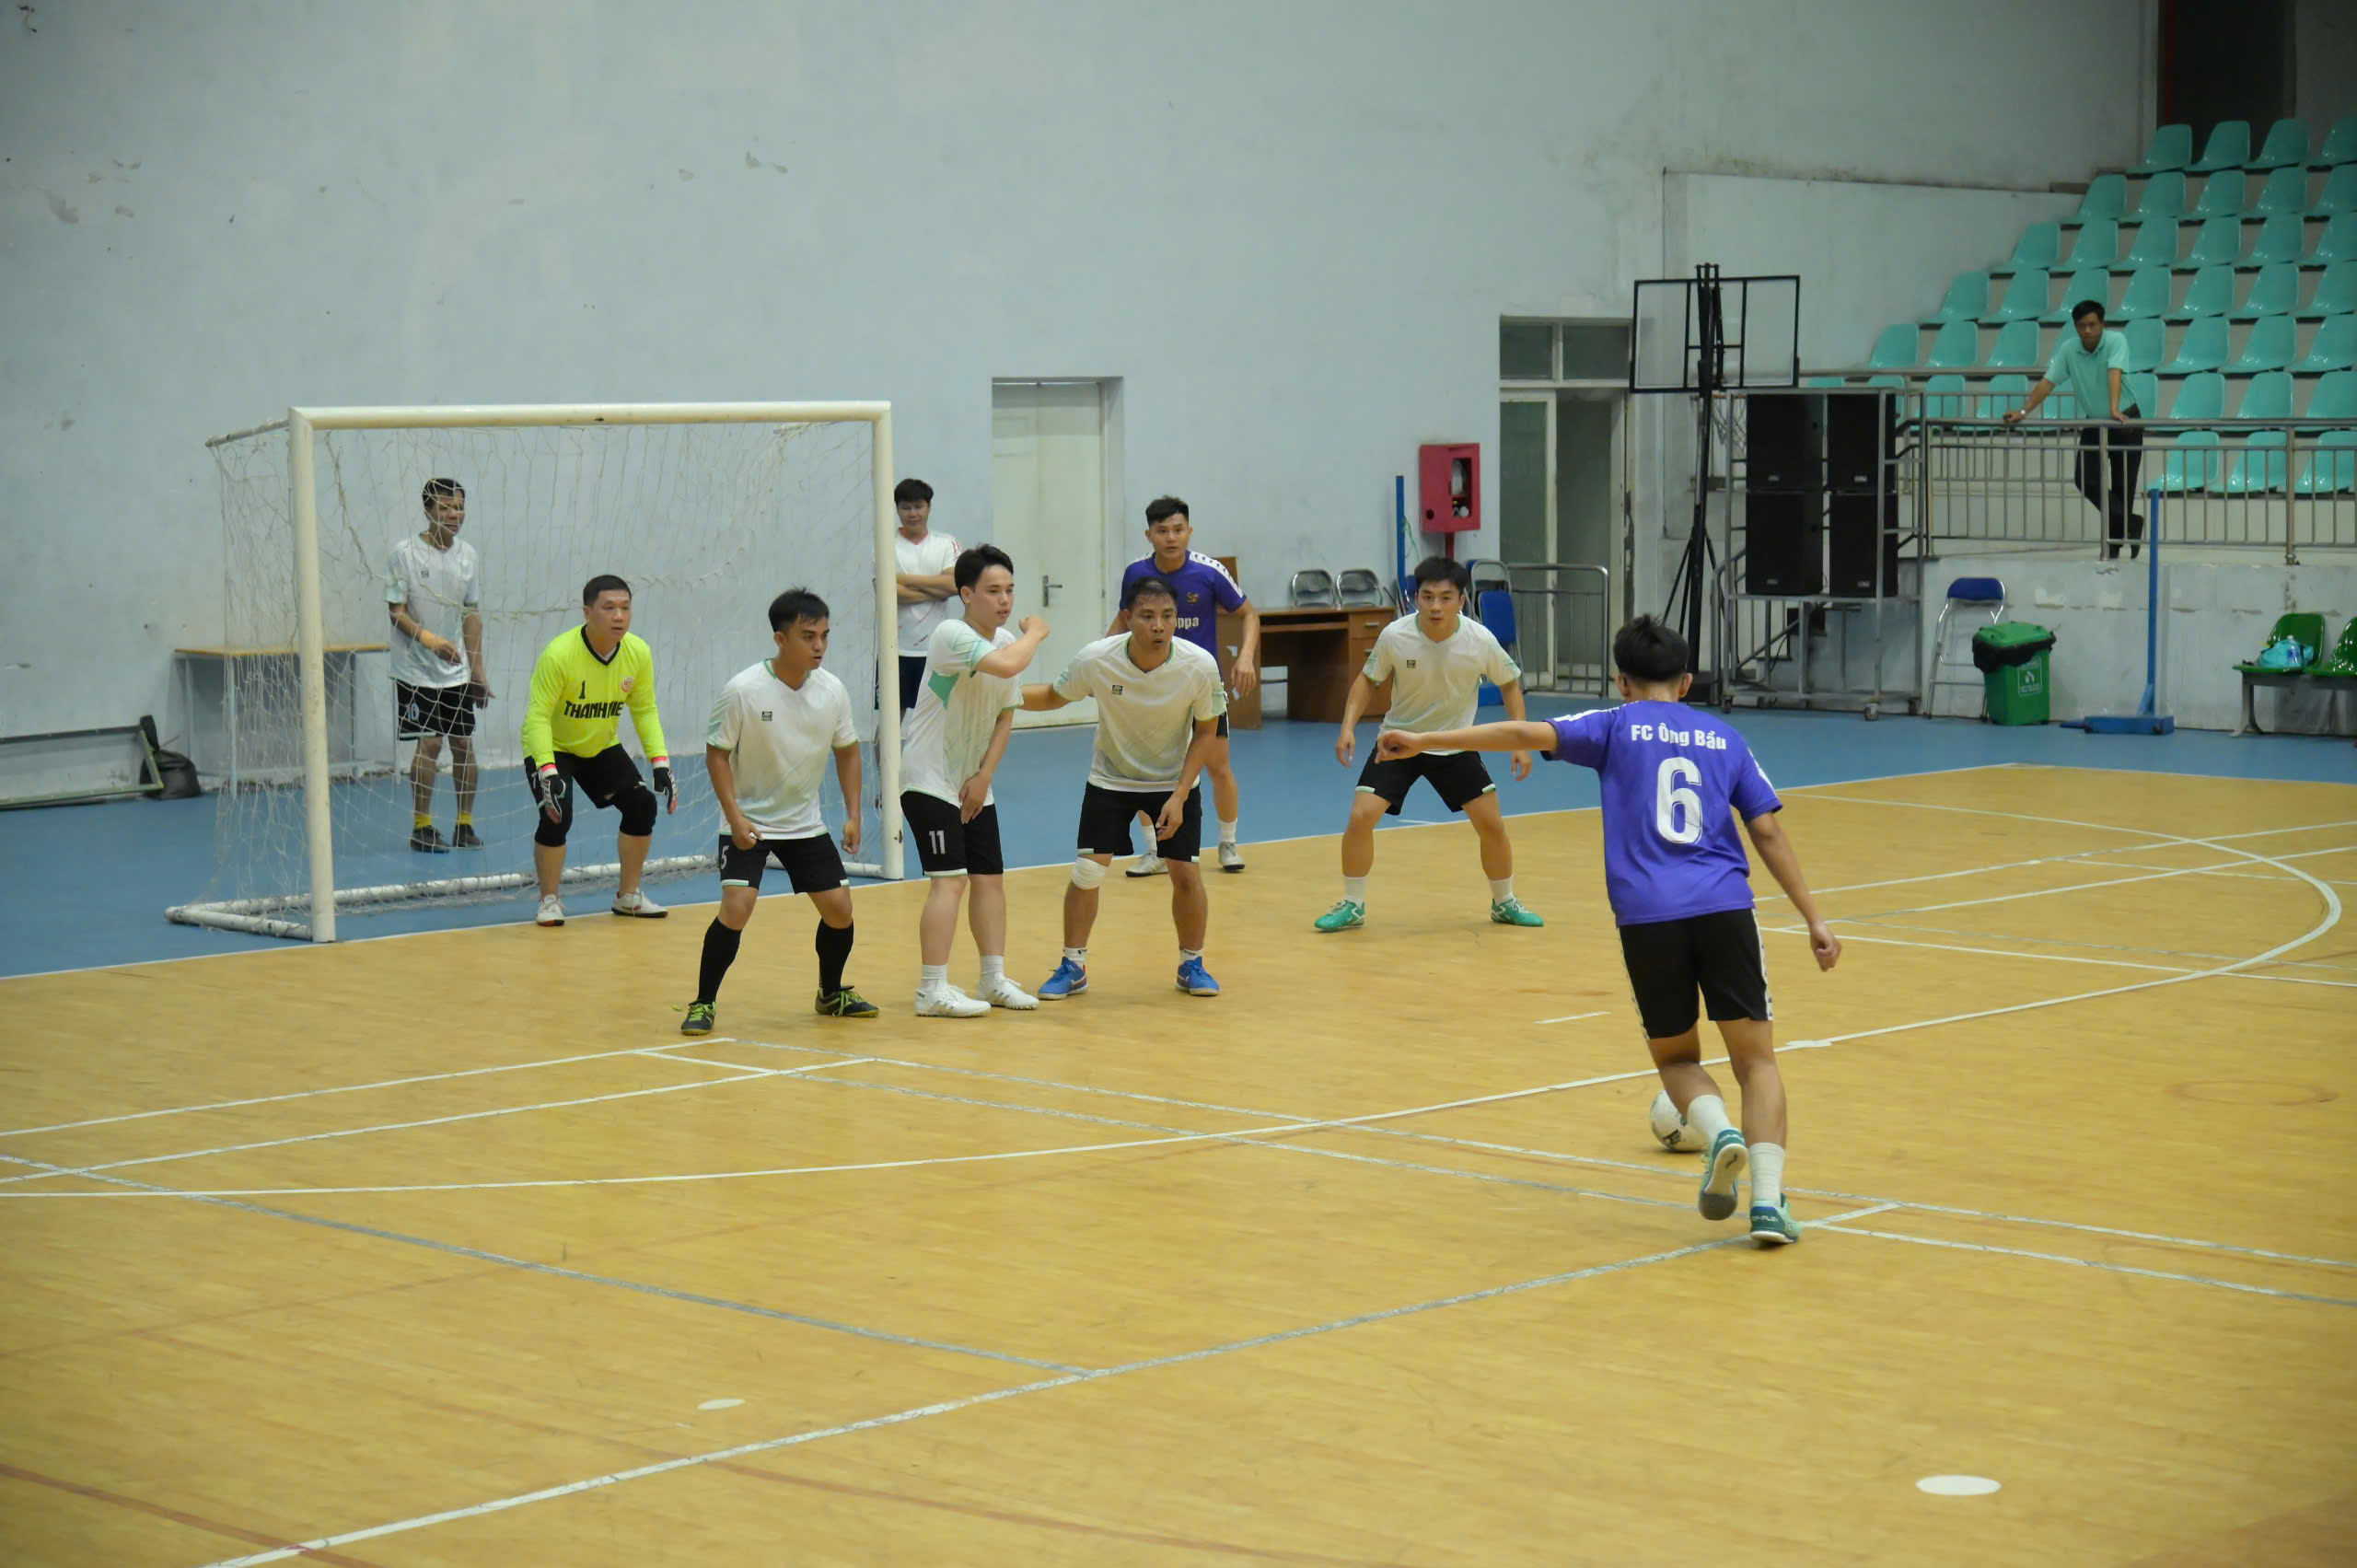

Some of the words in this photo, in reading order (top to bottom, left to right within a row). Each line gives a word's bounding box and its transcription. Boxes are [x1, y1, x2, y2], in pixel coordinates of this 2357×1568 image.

[1176, 617, 1200, 630] ppa
[579, 679, 586, 700] 1
[1631, 724, 1654, 741] FC
[1658, 722, 1689, 747] Ông
[1657, 757, 1701, 843] 6
[929, 830, 946, 854] 11
